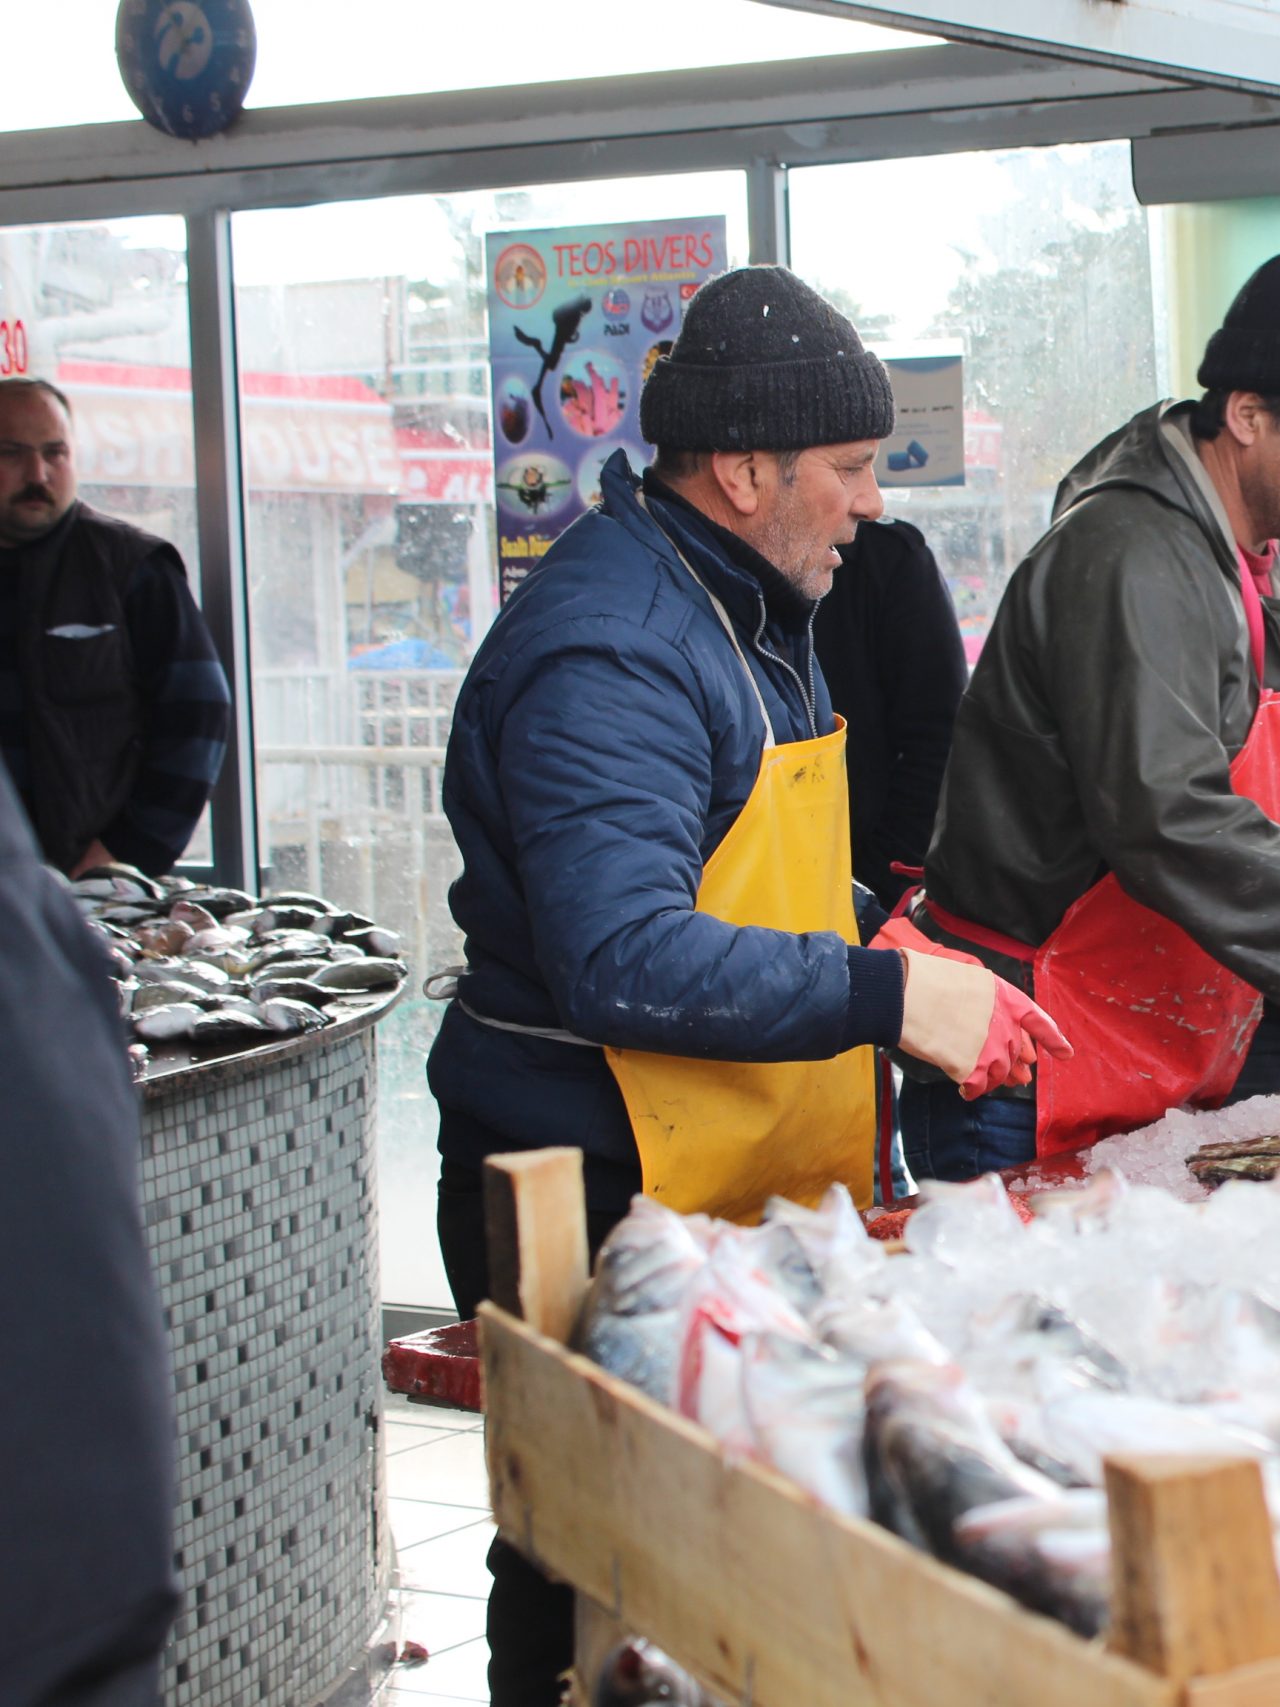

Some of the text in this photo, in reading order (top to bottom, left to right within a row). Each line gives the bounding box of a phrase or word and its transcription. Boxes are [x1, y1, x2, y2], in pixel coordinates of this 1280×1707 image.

[553, 232, 714, 277] TEOS DIVERS
[75, 411, 403, 485] ISH OUSE
